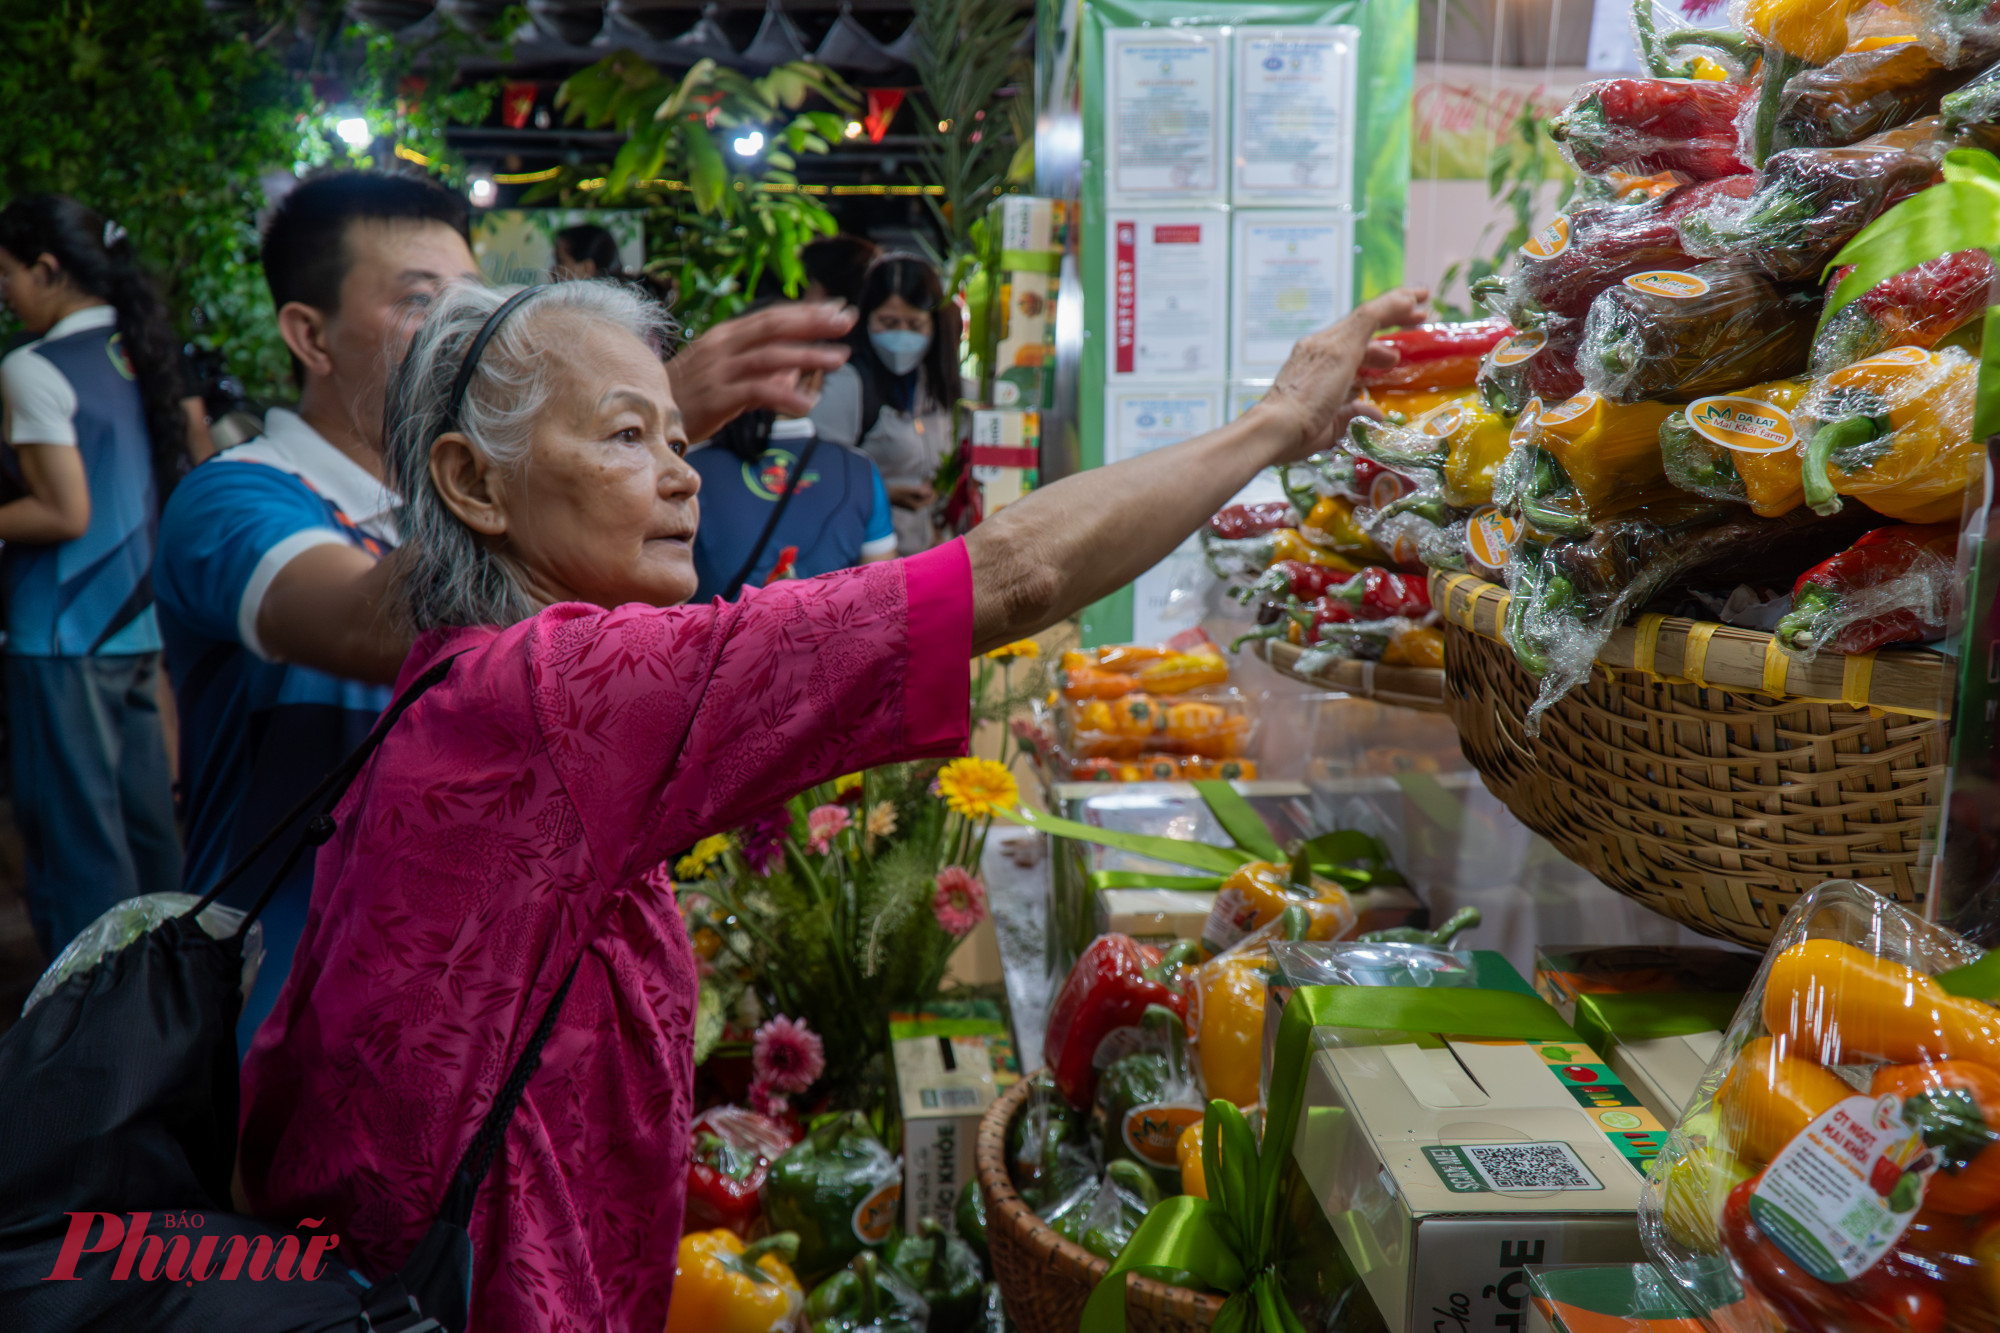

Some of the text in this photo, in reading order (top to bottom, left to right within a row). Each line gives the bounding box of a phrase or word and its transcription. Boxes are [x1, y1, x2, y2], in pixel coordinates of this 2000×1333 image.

[1118, 260, 1133, 347] VIETCERT
[1713, 418, 1786, 442] Mai Khôi farm
[1737, 413, 1776, 428] DA LAT
[1430, 1149, 1479, 1190] SCAN ME!
